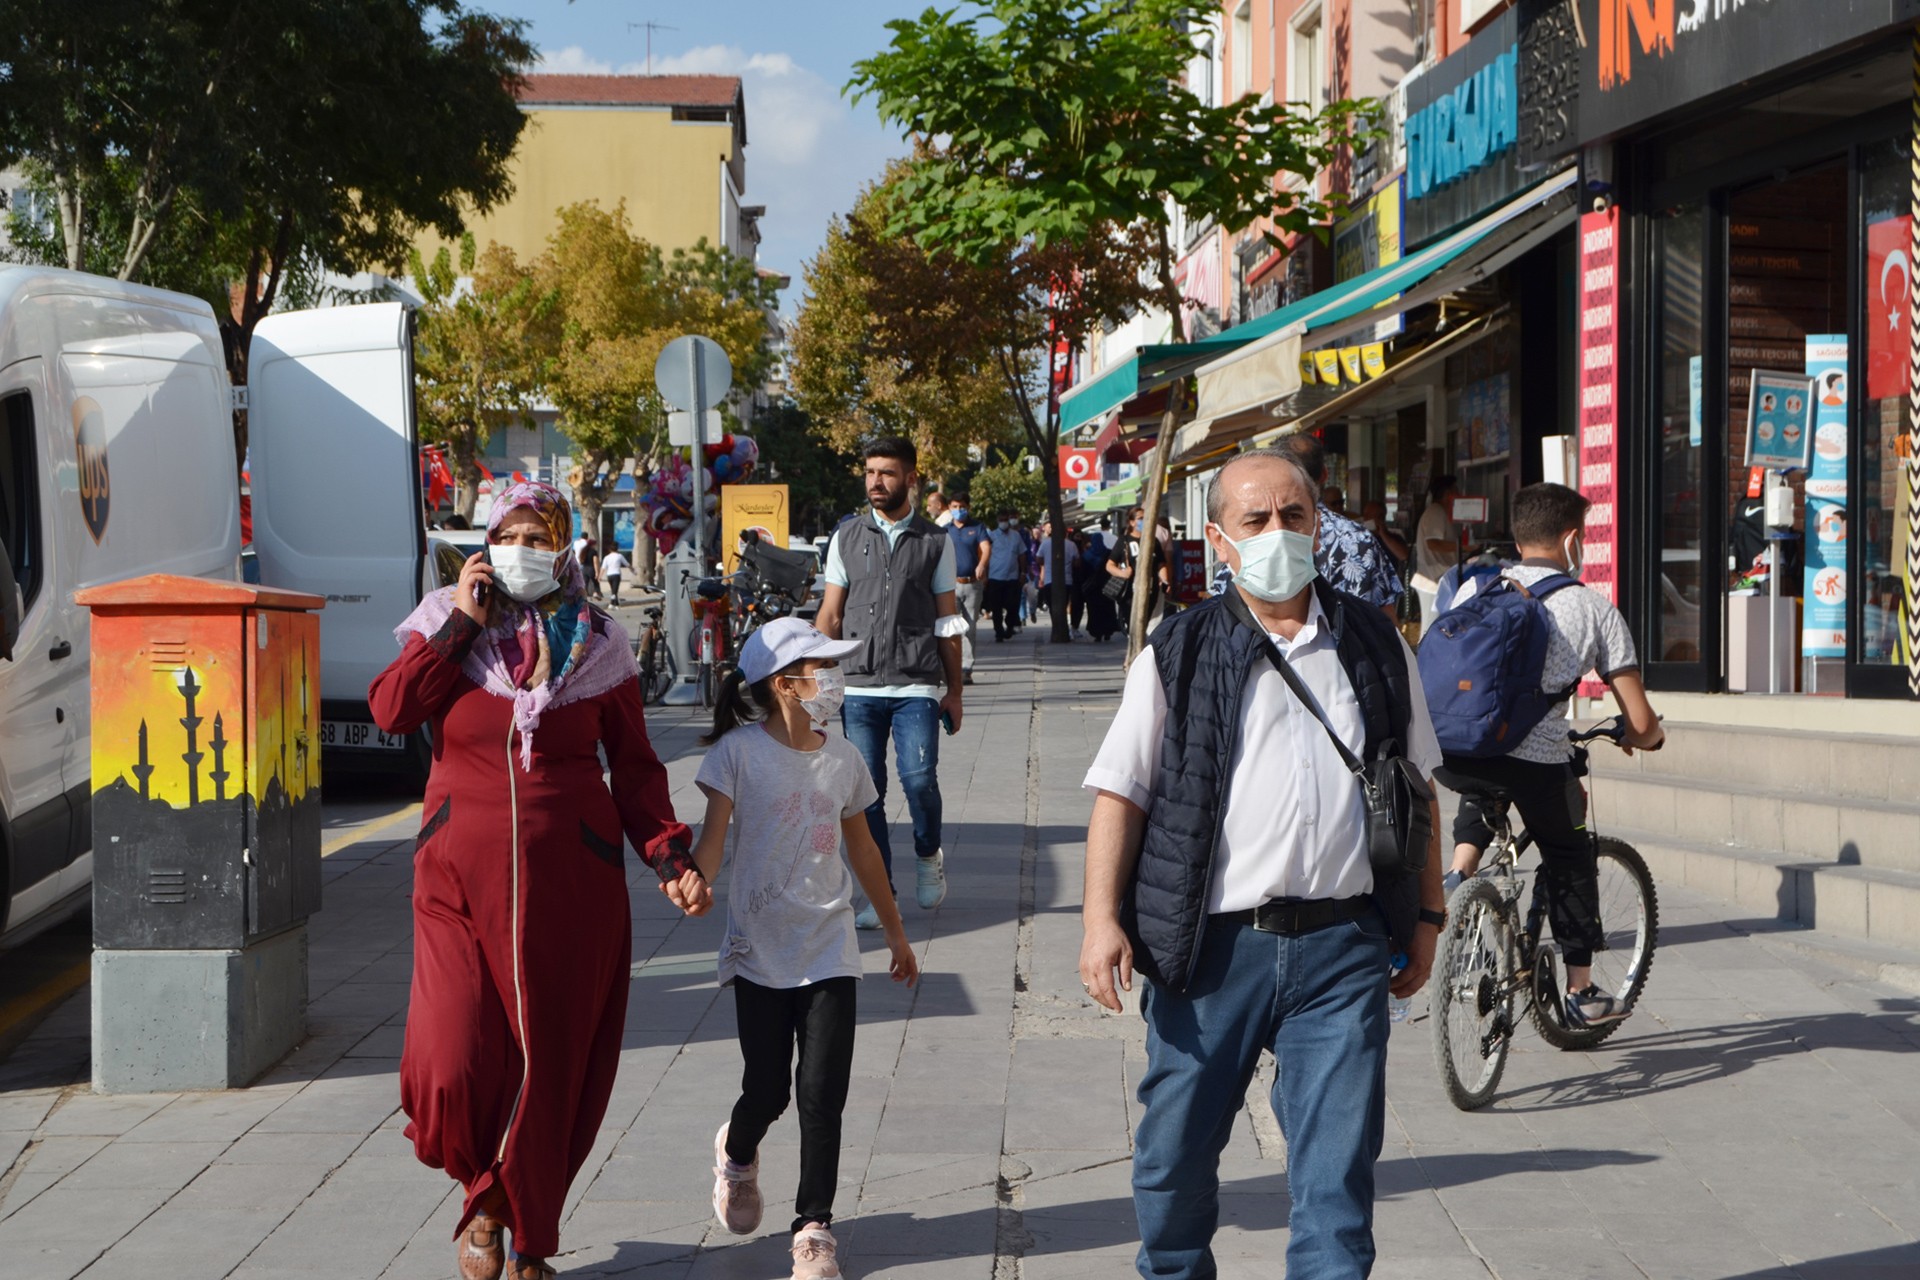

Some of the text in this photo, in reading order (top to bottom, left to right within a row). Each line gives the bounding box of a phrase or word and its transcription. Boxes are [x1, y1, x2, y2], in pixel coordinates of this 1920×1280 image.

[1405, 42, 1518, 201] TURKUA
[77, 442, 109, 522] ups
[344, 724, 369, 746] ABP
